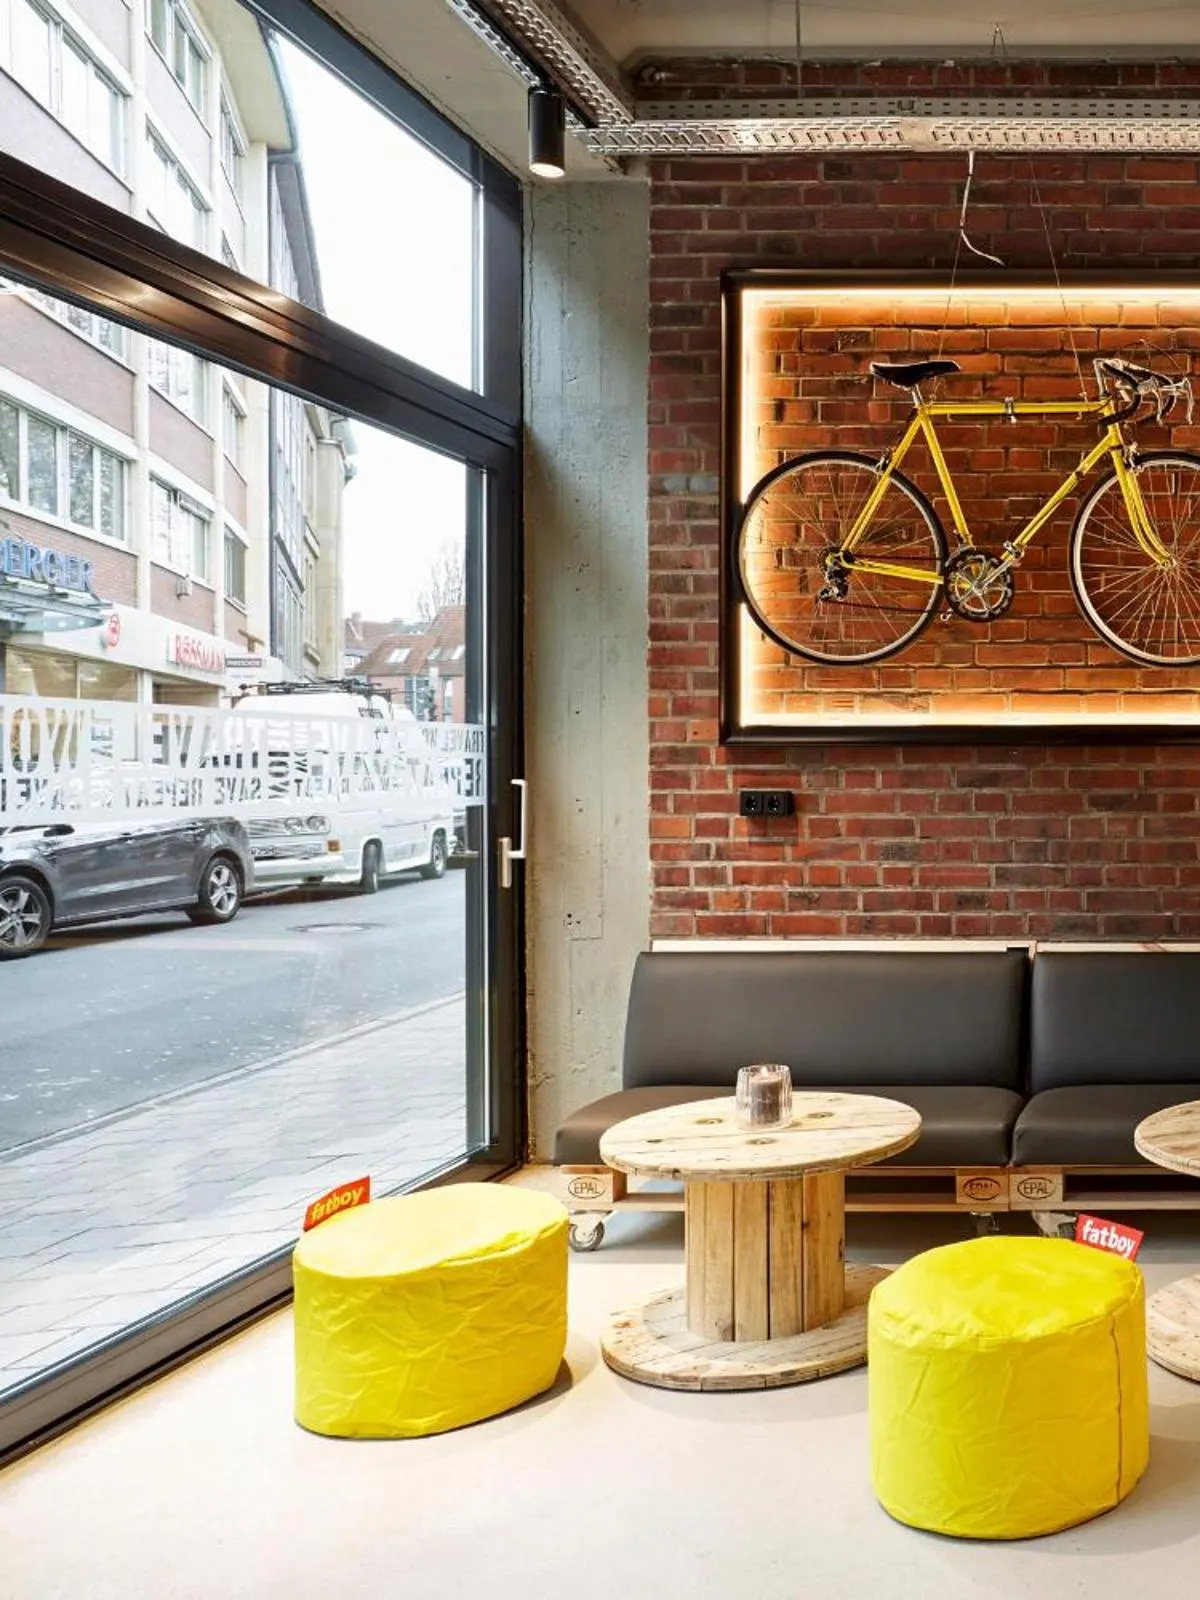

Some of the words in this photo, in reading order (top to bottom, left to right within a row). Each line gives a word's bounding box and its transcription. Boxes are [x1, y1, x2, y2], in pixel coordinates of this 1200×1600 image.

[574, 1182, 601, 1195] EPAL
[1024, 1181, 1049, 1195] EPAL
[311, 1187, 364, 1225] fatboy
[1082, 1219, 1137, 1258] fatboy
